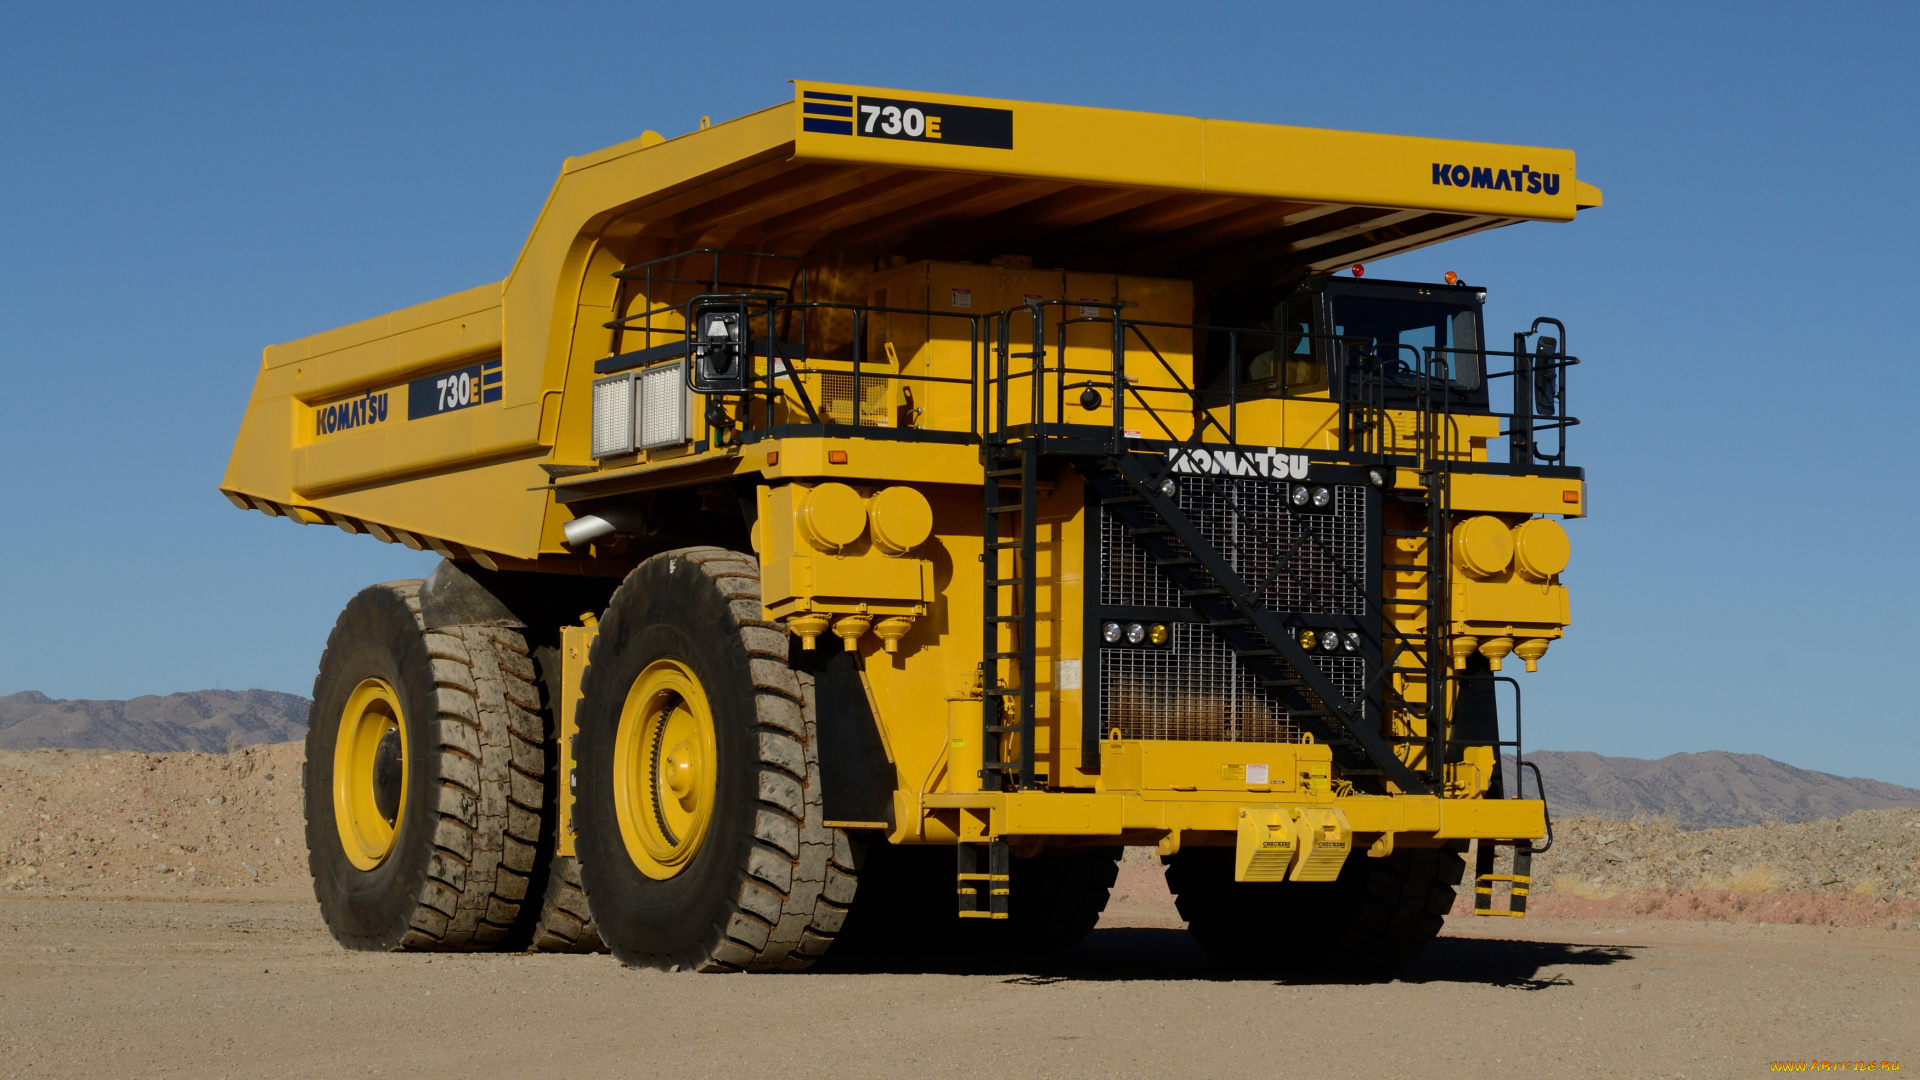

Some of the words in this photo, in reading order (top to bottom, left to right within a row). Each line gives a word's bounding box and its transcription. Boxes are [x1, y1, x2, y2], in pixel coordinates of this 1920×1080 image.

[860, 104, 942, 138] 730E
[1432, 163, 1560, 195] KOMATSU
[437, 372, 479, 411] 730E
[316, 388, 388, 436] KOMATSU
[1168, 446, 1309, 480] KOMATSU
